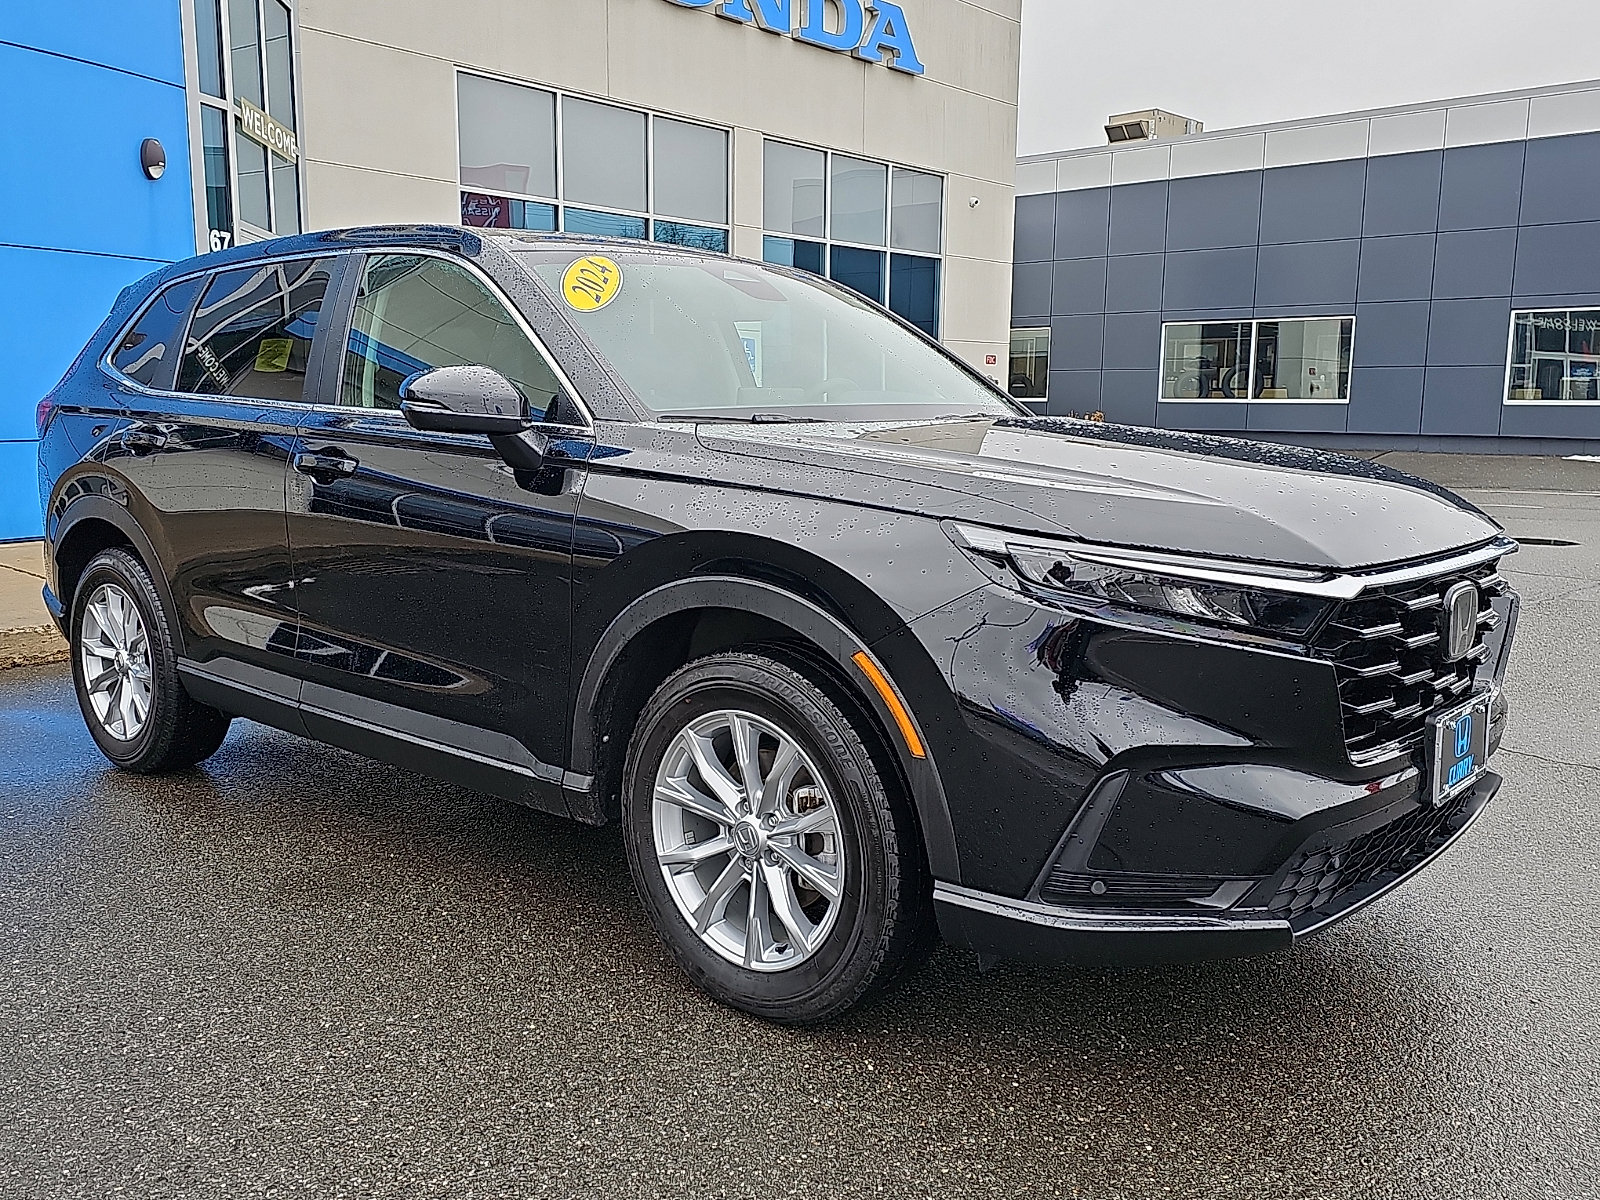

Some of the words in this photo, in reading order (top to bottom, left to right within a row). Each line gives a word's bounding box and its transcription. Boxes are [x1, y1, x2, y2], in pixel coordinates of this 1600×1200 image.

[241, 102, 296, 159] WELCOME
[209, 229, 231, 251] 67
[571, 258, 613, 304] 2024
[1448, 753, 1475, 786] CURRY
